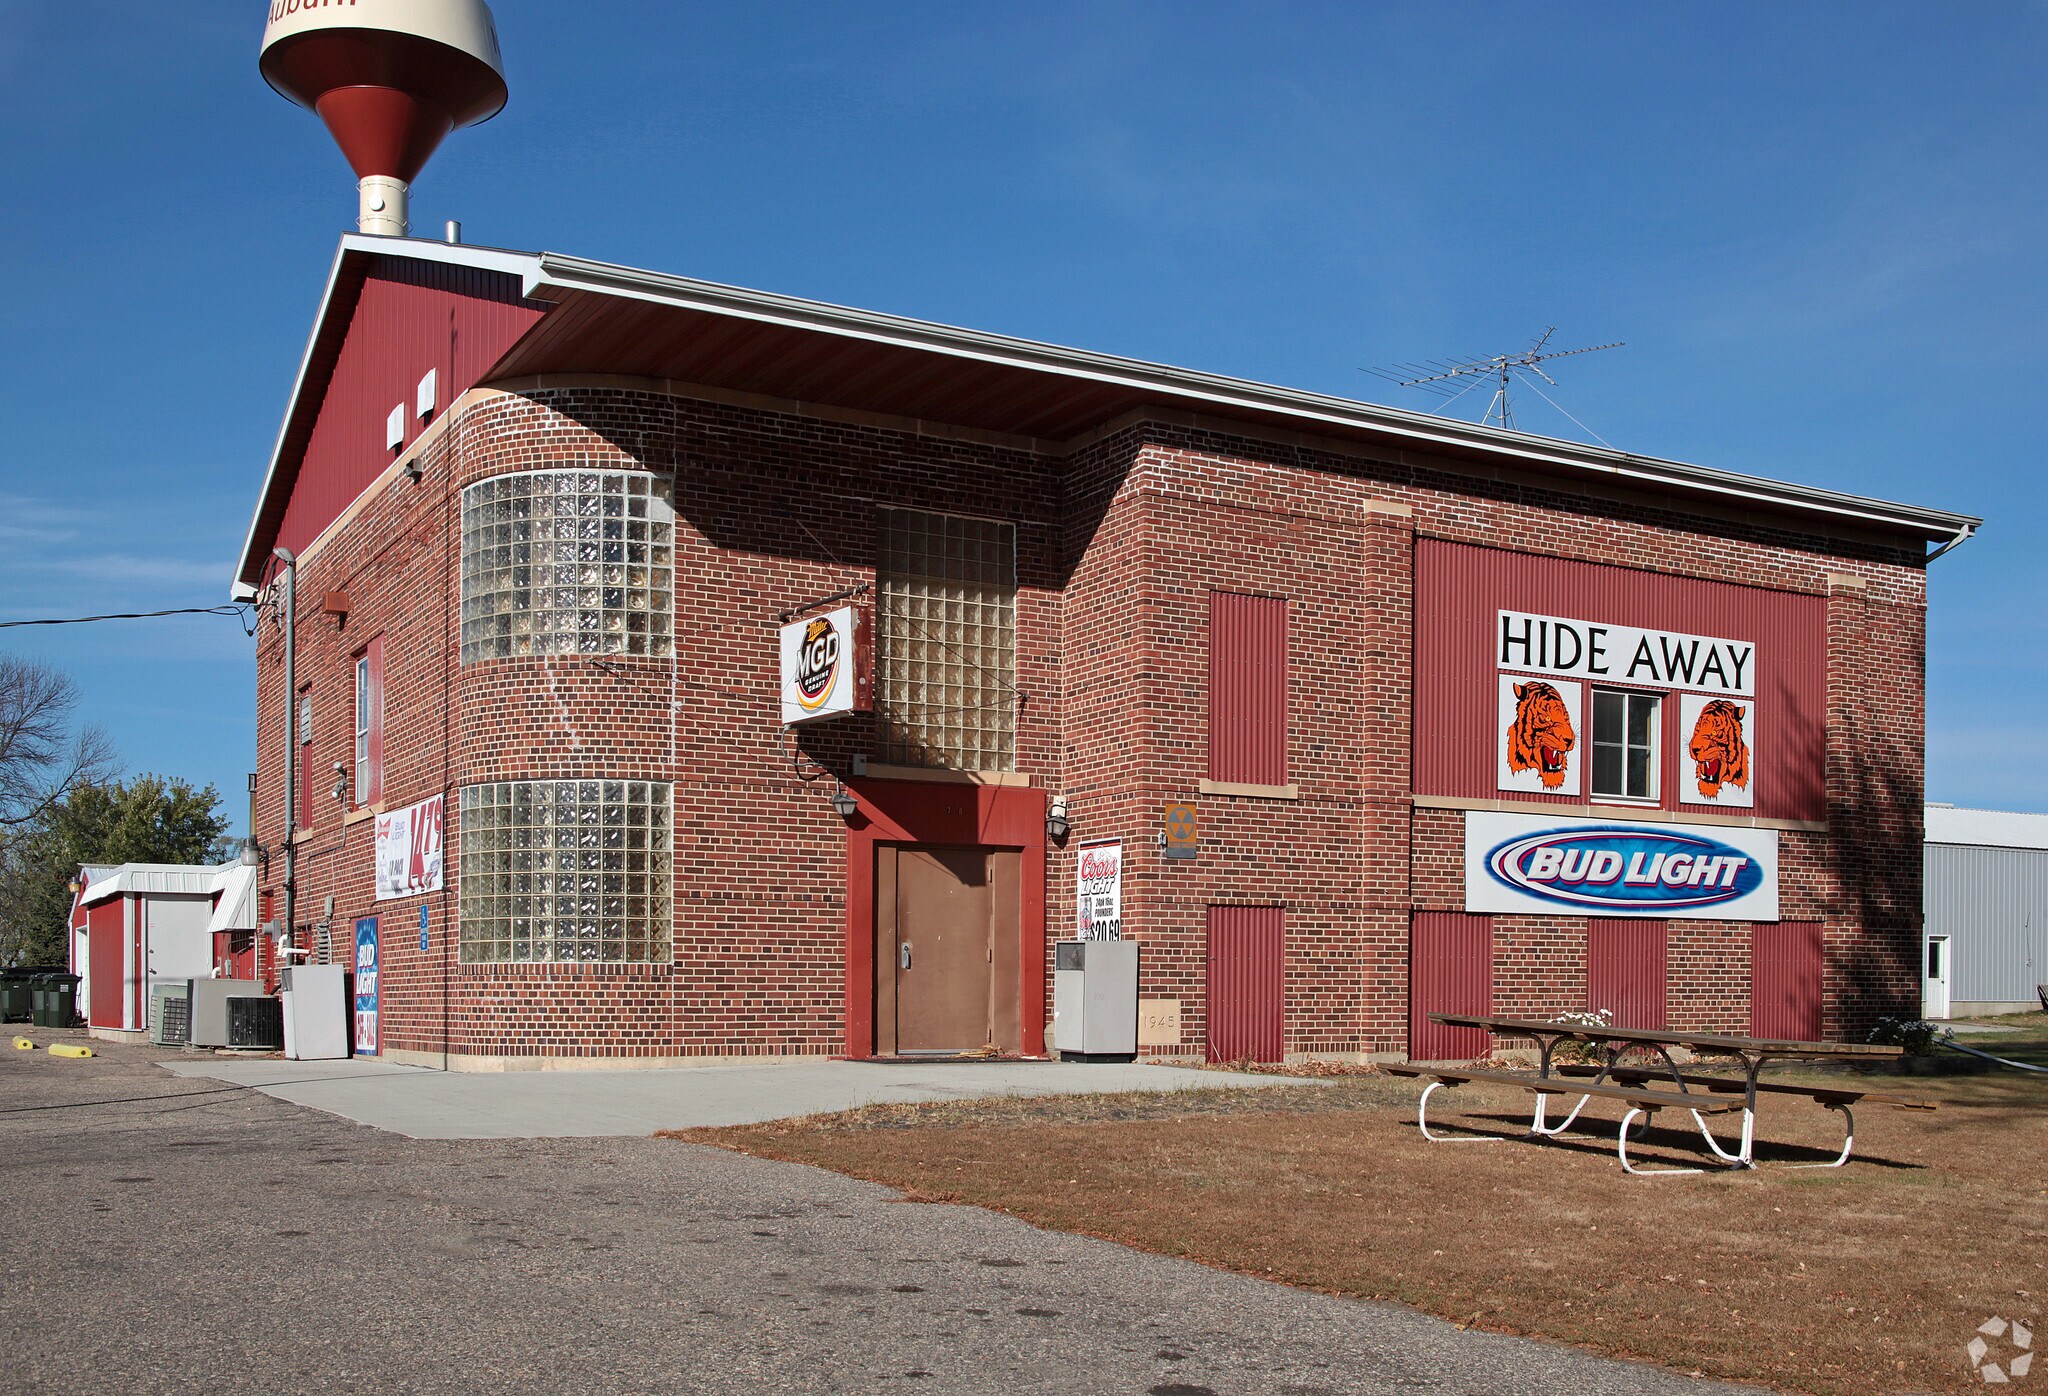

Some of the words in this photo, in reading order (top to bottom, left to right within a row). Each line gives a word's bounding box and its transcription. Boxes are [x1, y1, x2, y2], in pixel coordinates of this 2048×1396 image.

[807, 620, 828, 639] Miller
[795, 631, 840, 683] MGD
[1501, 616, 1609, 674] HIDE
[1626, 634, 1751, 689] AWAY
[805, 670, 830, 686] GENUINE
[1081, 852, 1117, 880] Coors
[1526, 847, 1624, 884] BUD
[1624, 852, 1749, 889] LIGHT
[1080, 877, 1115, 896] LIGHT
[359, 944, 375, 968] BUD
[356, 971, 377, 996] LIGHT
[1144, 1015, 1175, 1029] 1945
